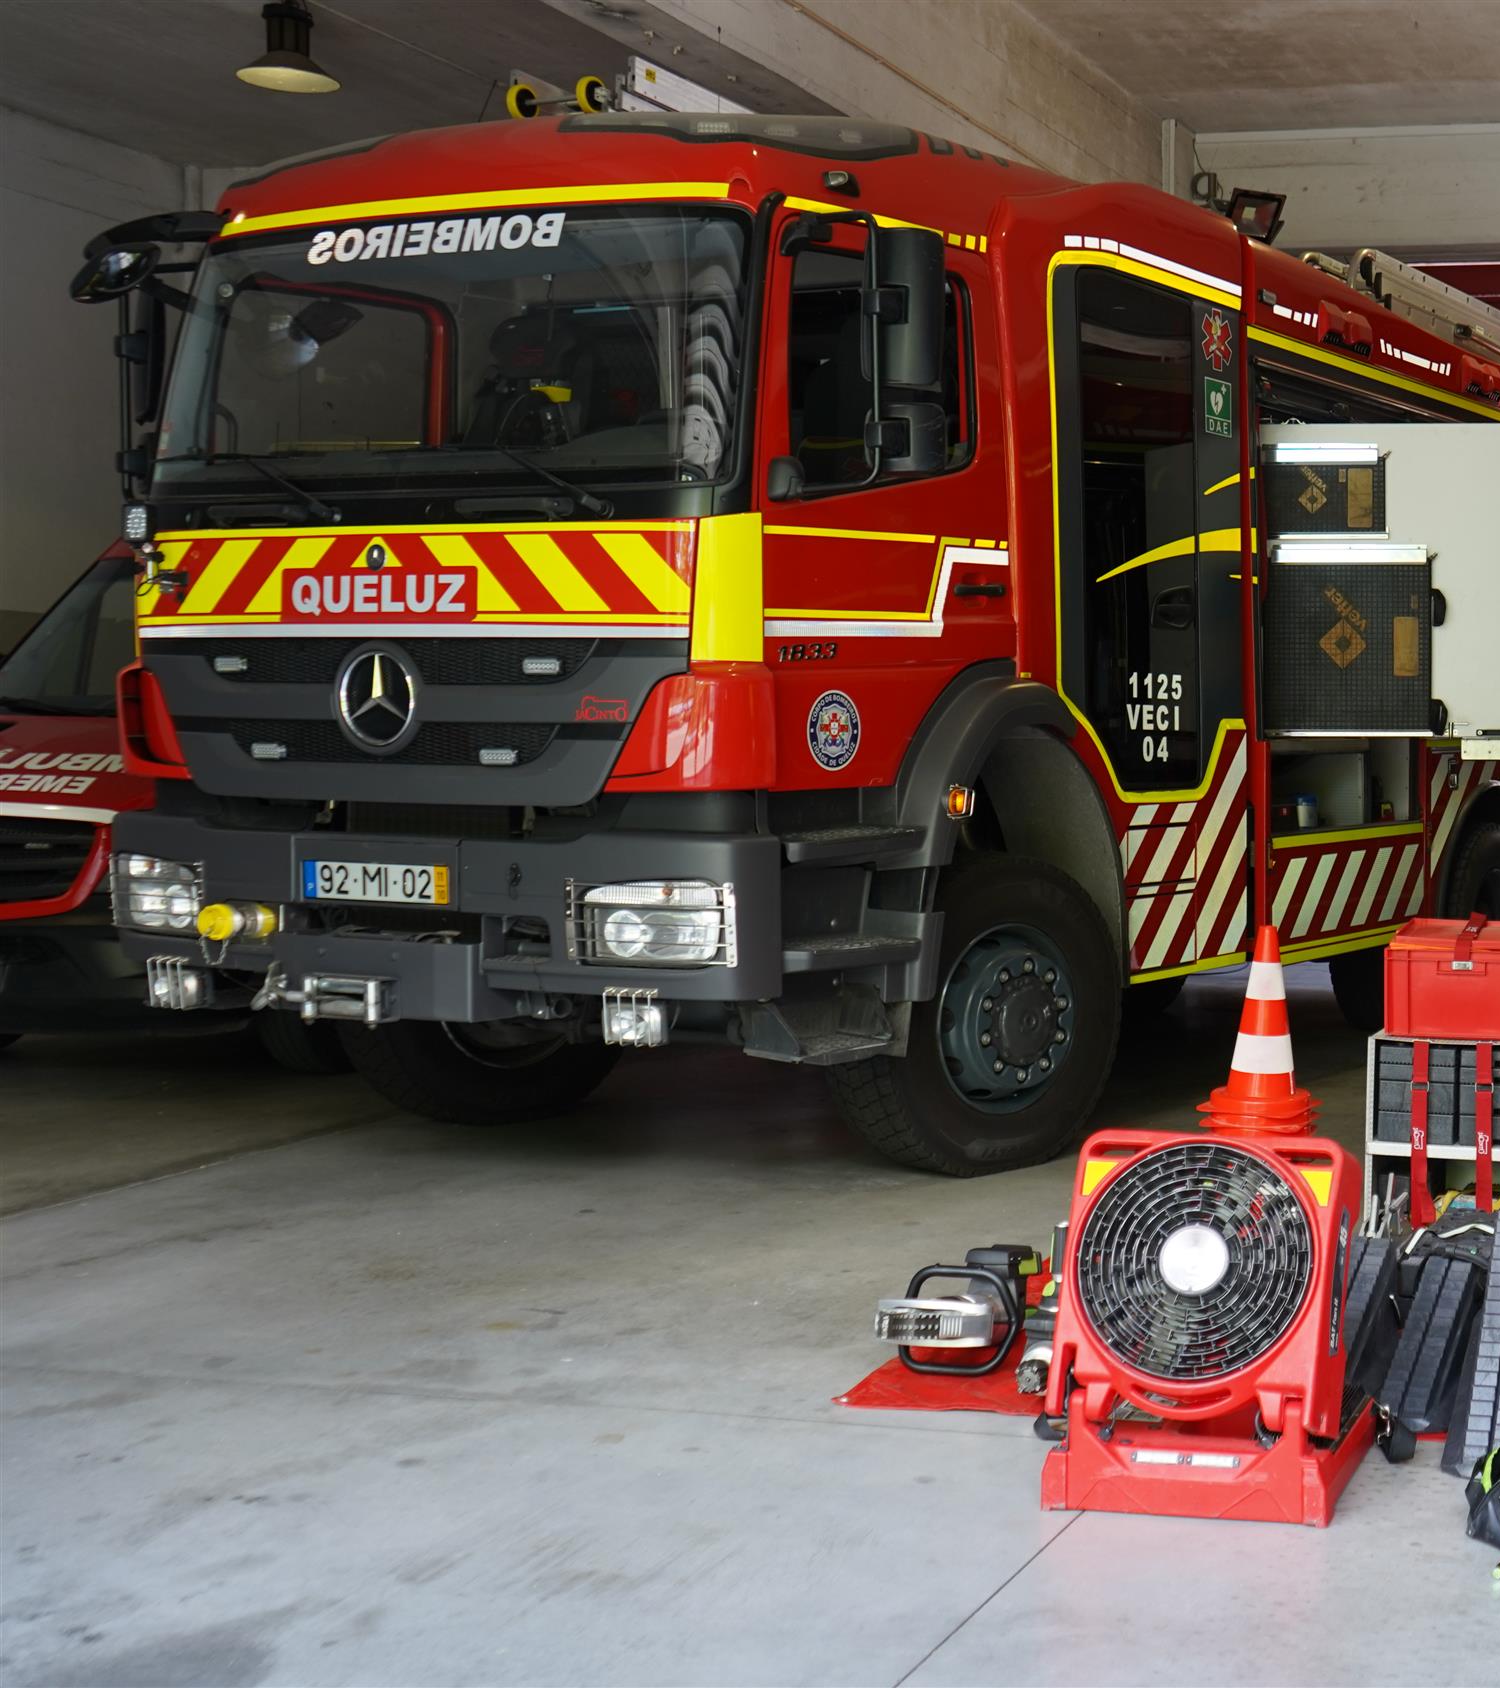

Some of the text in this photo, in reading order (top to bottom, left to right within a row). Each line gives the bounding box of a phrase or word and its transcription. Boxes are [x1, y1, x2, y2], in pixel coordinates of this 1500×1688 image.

[1208, 419, 1231, 435] DAE
[290, 573, 467, 616] QUELUZ
[778, 642, 837, 662] 1833
[1128, 671, 1183, 700] 1125
[1142, 736, 1170, 763] 04
